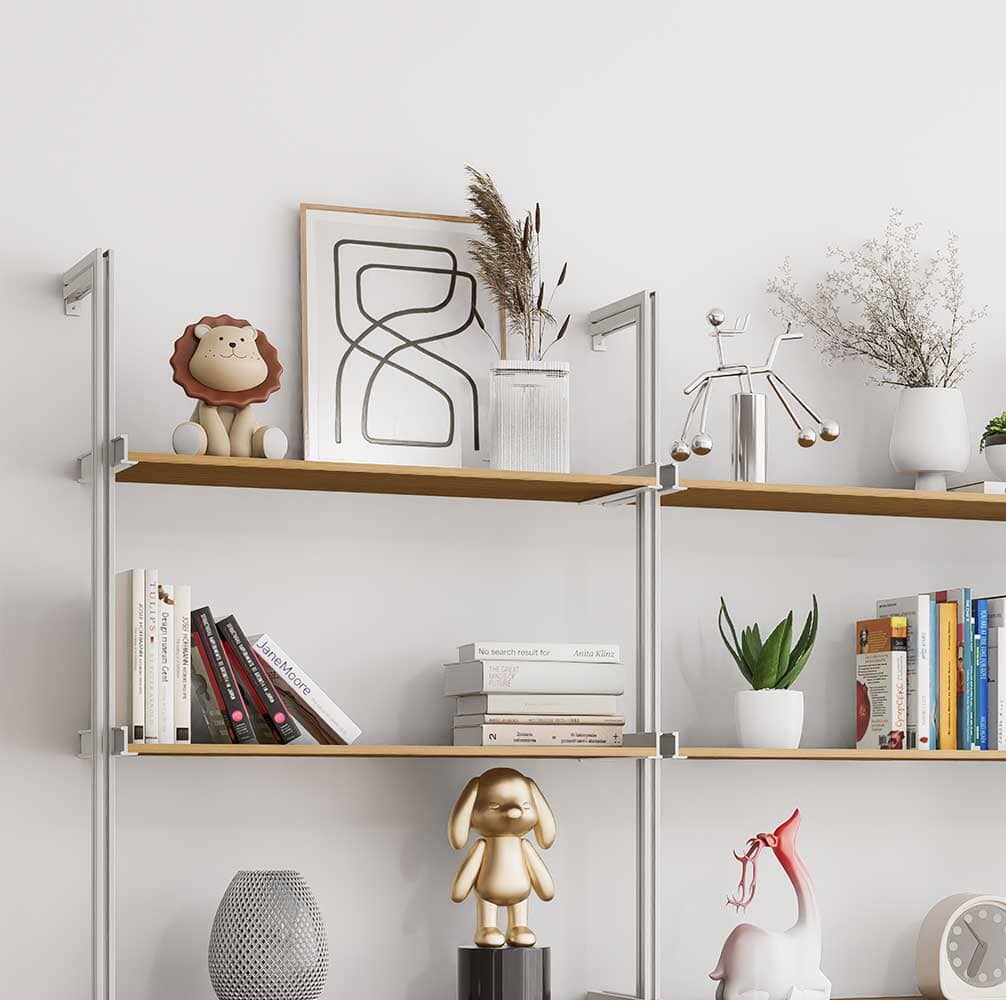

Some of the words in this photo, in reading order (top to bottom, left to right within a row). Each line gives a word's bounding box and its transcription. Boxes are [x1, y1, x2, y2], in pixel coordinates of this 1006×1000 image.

[160, 611, 169, 635] Design
[161, 636, 169, 664] museum
[478, 647, 489, 655] No
[491, 648, 516, 656] search
[517, 648, 538, 656] result
[540, 648, 551, 656] for
[573, 649, 595, 657] Anita
[256, 640, 312, 696] JaneMoore
